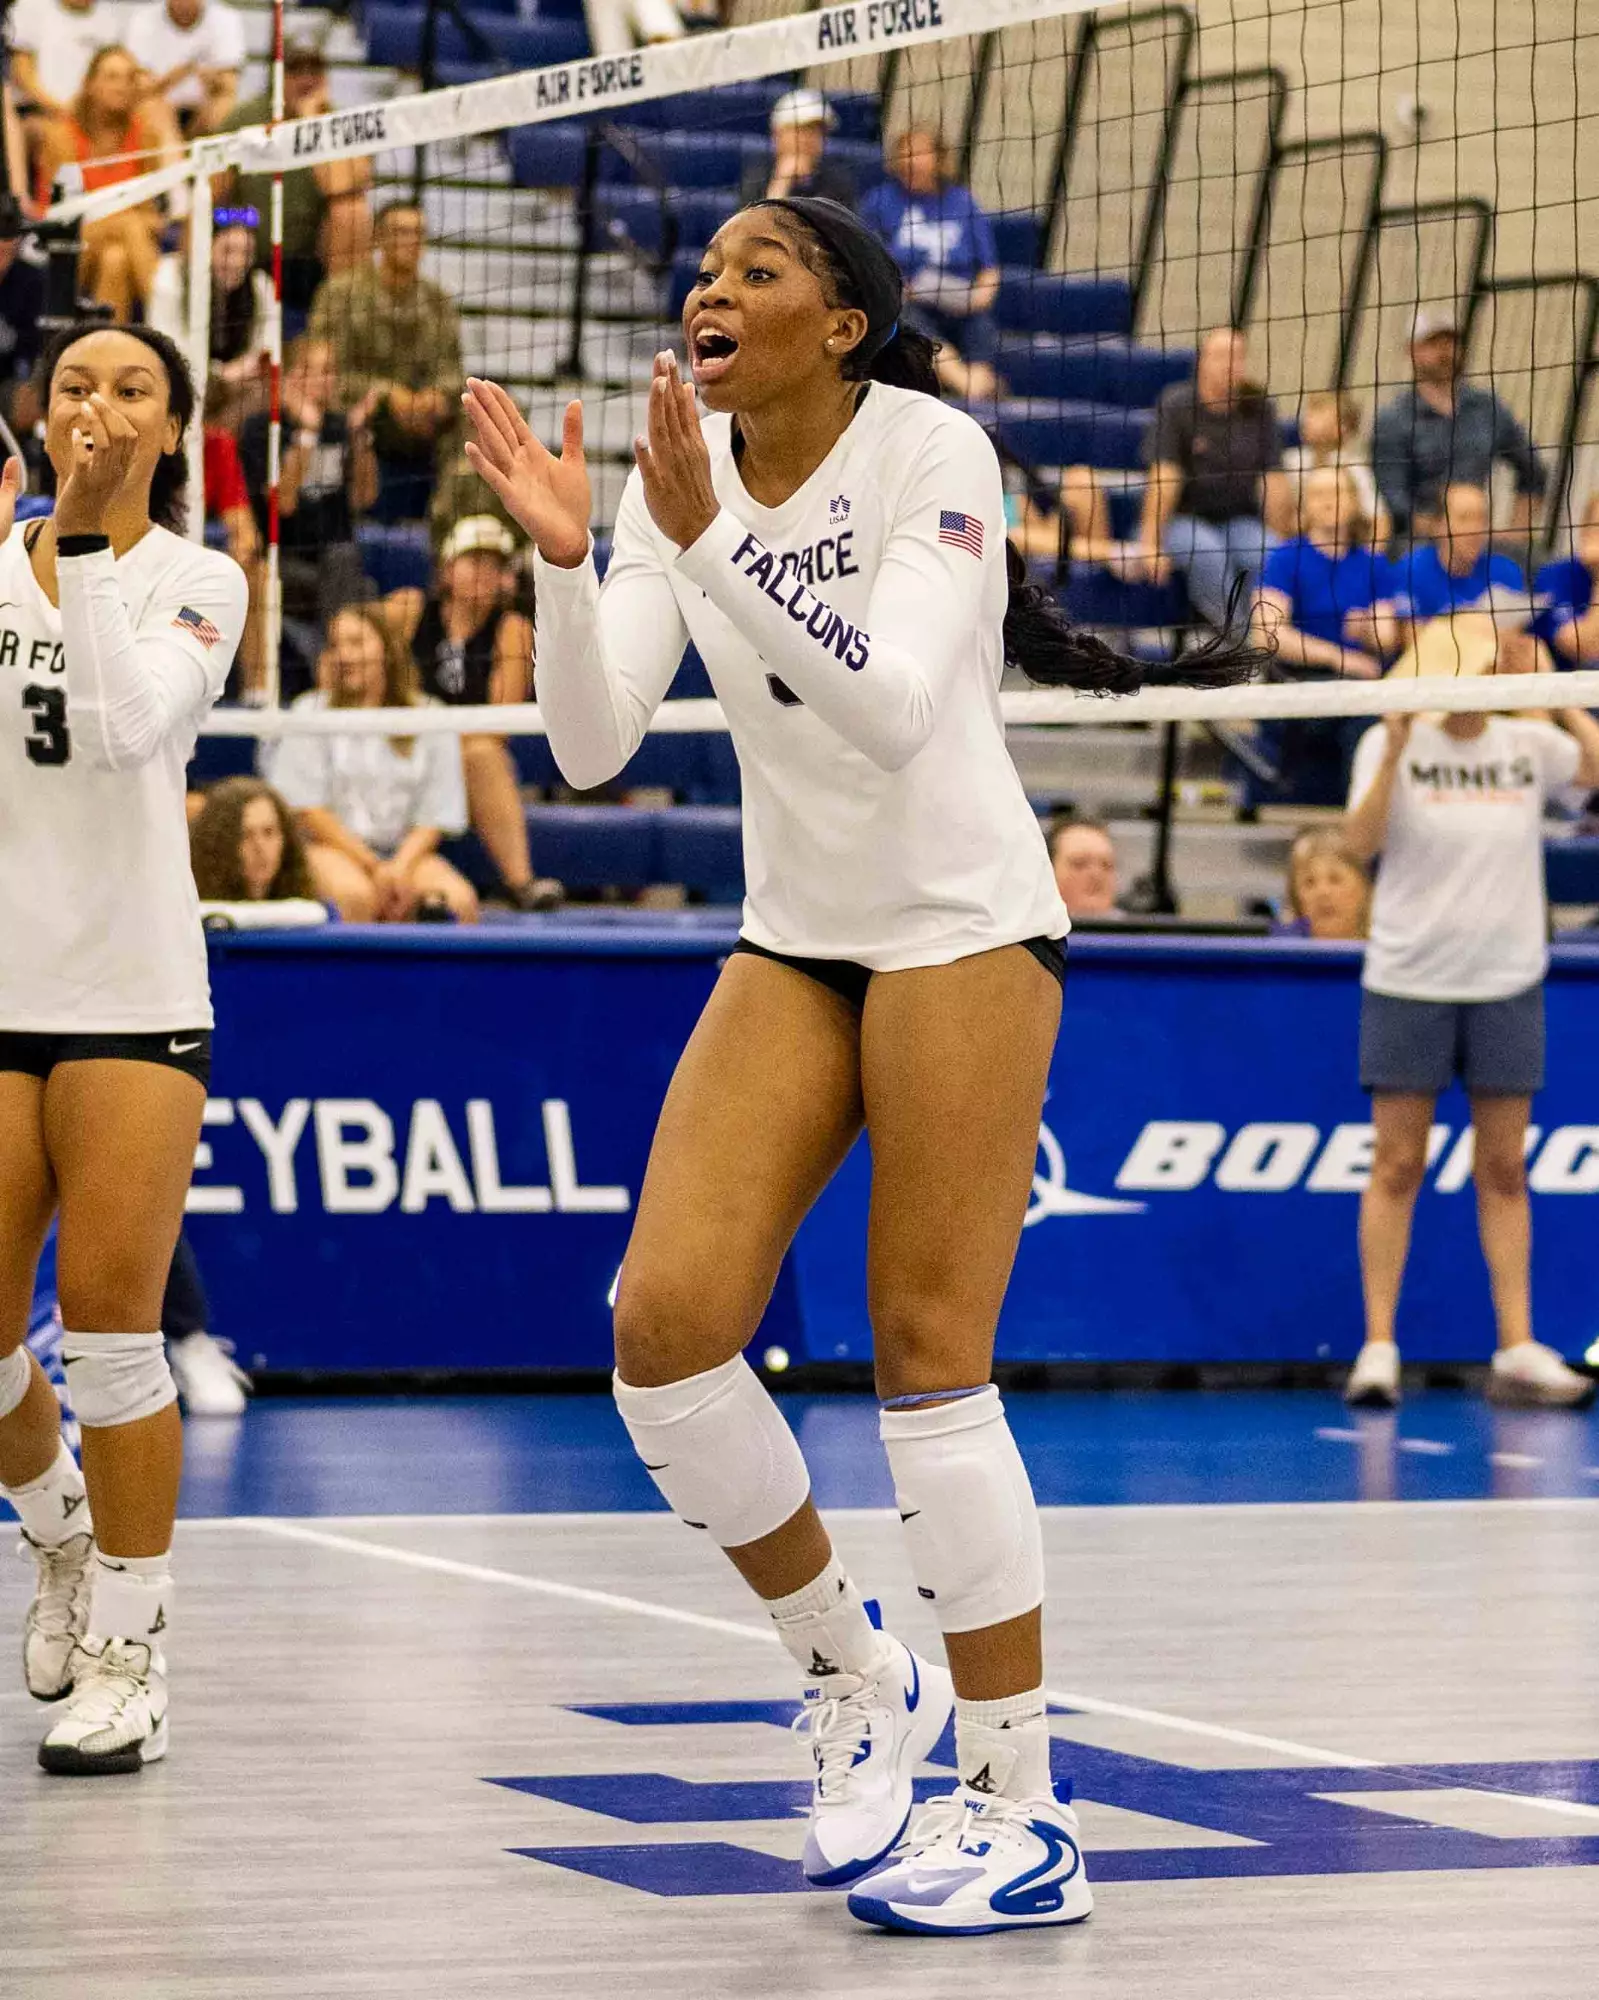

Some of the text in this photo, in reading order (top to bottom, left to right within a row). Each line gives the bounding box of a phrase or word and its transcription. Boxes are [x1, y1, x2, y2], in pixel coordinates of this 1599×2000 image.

[819, 0, 942, 49] AIR FORCE
[537, 55, 643, 109] AIR FORCE
[331, 109, 385, 149] FORCE
[730, 532, 870, 671] FALCONS
[0, 629, 20, 666] R
[22, 682, 72, 767] 3
[1409, 758, 1533, 790] MINES
